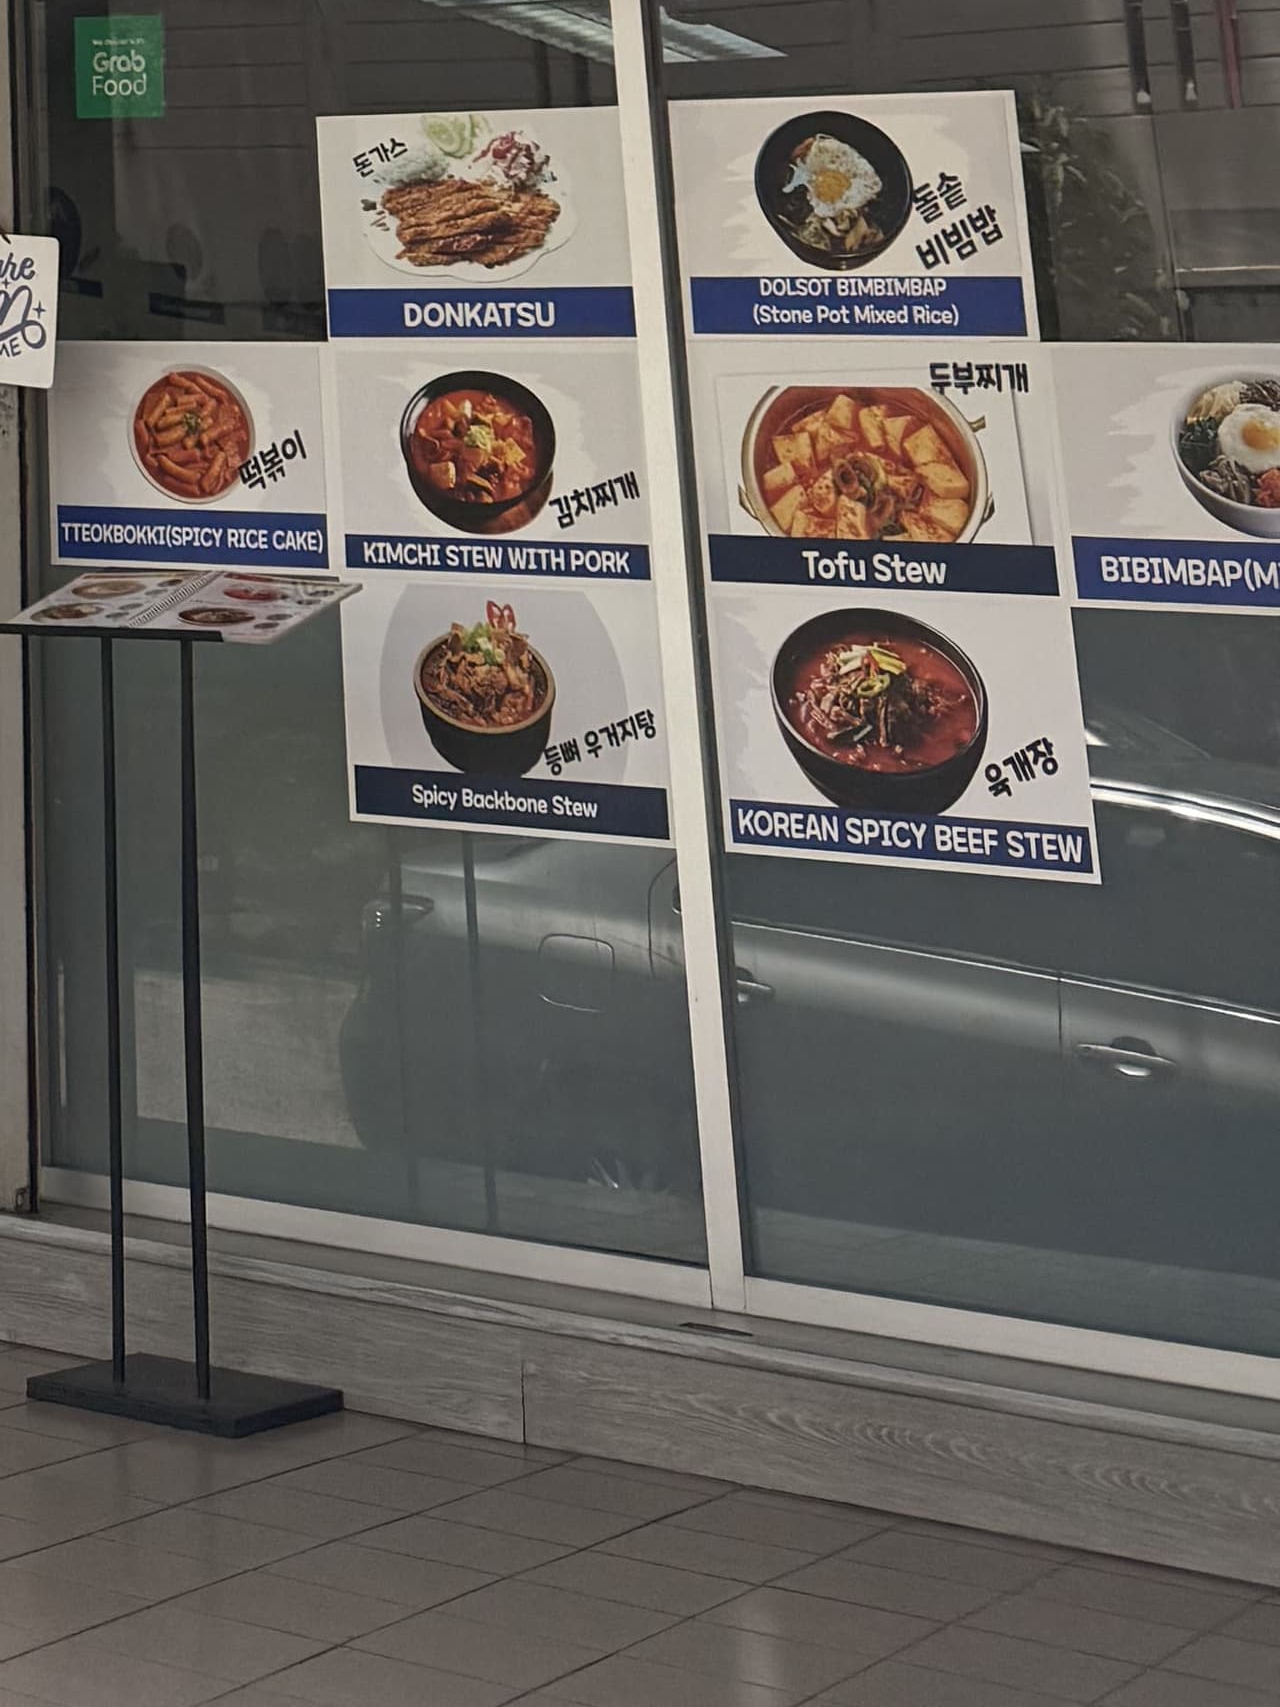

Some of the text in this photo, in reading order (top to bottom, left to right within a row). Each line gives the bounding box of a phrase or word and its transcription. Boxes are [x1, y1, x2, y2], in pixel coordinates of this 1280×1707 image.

[93, 49, 145, 73] Grab
[93, 73, 146, 95] Food
[352, 138, 407, 179] 돈가스
[916, 204, 1004, 270] 비빔밥
[760, 278, 946, 297] DOLSOT BIMBIMBAP
[403, 302, 555, 328] DONKATSU
[752, 304, 960, 327] (Stone Pot Mixed Rice)
[929, 362, 1029, 394] 두부찌개
[238, 430, 307, 490] 떡볶이
[549, 471, 640, 529] 김치찌개
[61, 523, 323, 553] TTEOKBOKKI(SPICY RICE CAKE)
[363, 542, 630, 574] KIMCHI STEW WITH PORK
[802, 550, 947, 584] Tofu Stew
[543, 709, 657, 776] 등뼈 우거지탕
[985, 737, 1058, 798] 육개장
[412, 785, 597, 818] Spicy Backbone Stew
[737, 808, 1083, 863] KOREAN SPICY BEEF STEW
